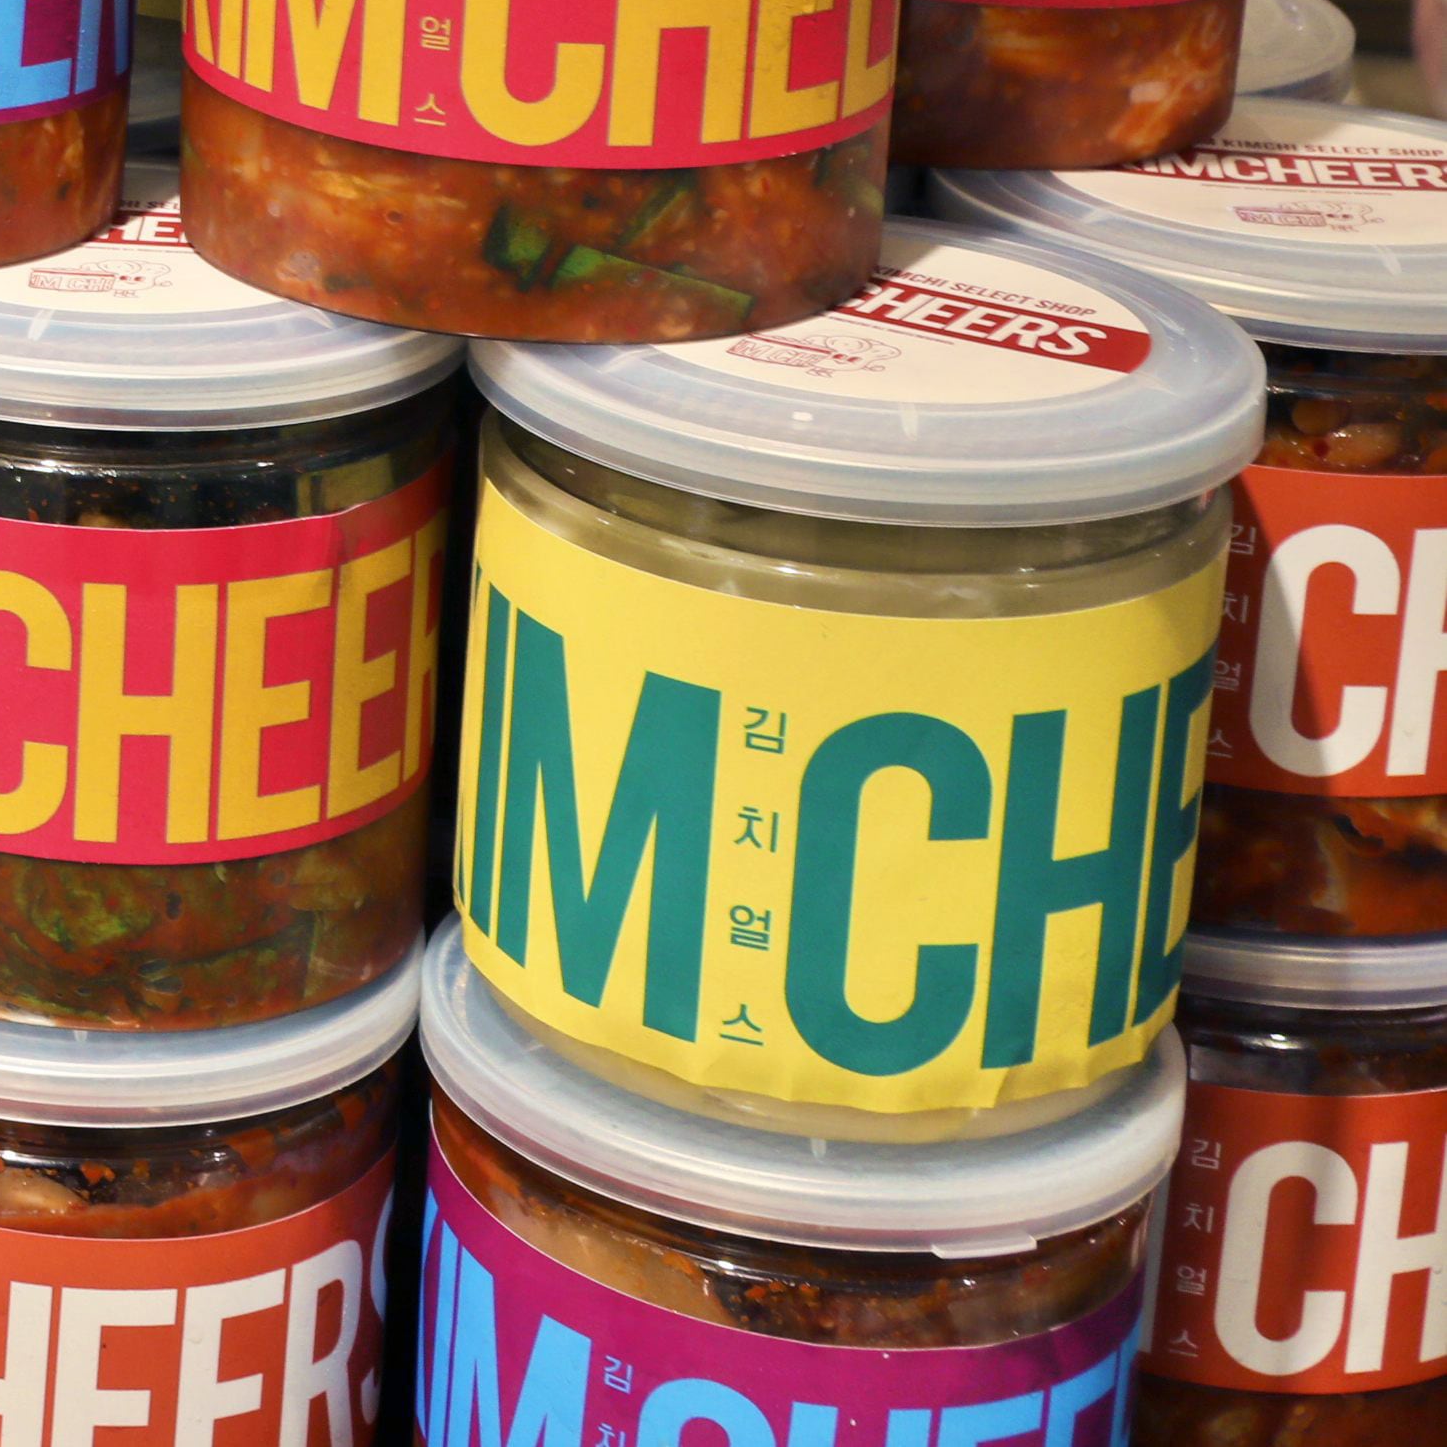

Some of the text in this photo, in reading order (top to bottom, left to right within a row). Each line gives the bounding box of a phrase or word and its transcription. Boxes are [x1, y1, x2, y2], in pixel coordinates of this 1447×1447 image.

[1123, 152, 1447, 188] IMCHEER
[949, 282, 1032, 306] SELECT
[1037, 299, 1098, 318] SHOP
[455, 558, 722, 1045] IM
[717, 707, 789, 1049] 김치얼스
[1163, 1138, 1223, 1359] 김치얼스
